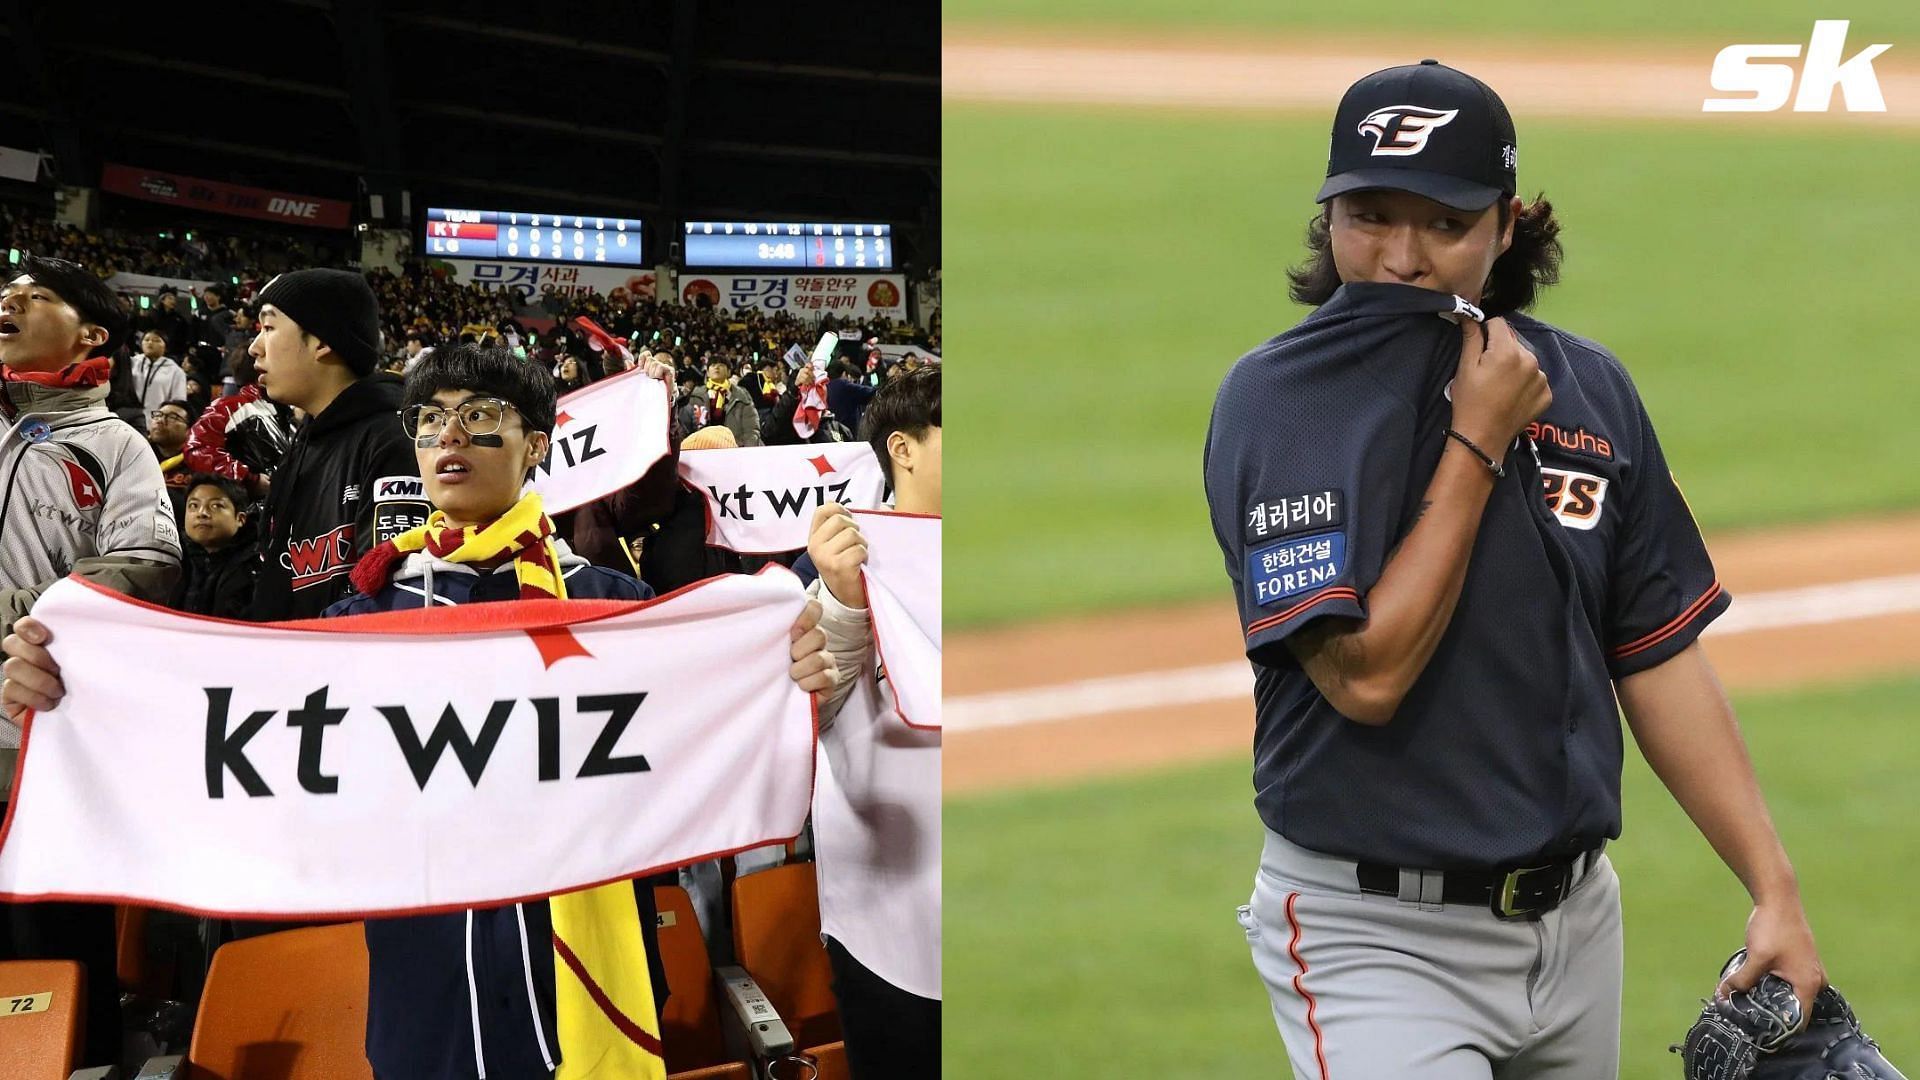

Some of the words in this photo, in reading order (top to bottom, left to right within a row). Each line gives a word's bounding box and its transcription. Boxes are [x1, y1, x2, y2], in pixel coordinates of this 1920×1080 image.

[266, 197, 321, 219] ONE
[443, 209, 480, 223] TEAM
[510, 213, 516, 224] 1
[531, 214, 539, 225] 2
[553, 215, 561, 226] 3
[574, 217, 582, 228] 4
[685, 222, 693, 233] 7
[704, 223, 712, 233] 8
[725, 223, 733, 233] 9
[744, 223, 757, 234] 10
[766, 223, 777, 234] 11
[787, 224, 800, 234] 12
[508, 227, 518, 241] 0
[530, 228, 540, 242] 0
[552, 230, 562, 243] 0
[574, 231, 584, 244] 0
[596, 232, 604, 245] 1
[617, 233, 627, 247] 0
[508, 242, 518, 256] 0
[530, 243, 540, 257] 0
[574, 246, 584, 259] 0
[595, 247, 605, 261] 2
[856, 253, 865, 266] 2
[876, 253, 884, 267] 1
[540, 266, 580, 283] 사과
[729, 278, 788, 309] 문경
[380, 481, 423, 496] KMI
[1249, 492, 1336, 536] 갤러리아
[1262, 539, 1331, 574] 한화건설
[1257, 562, 1337, 600] FORENA
[202, 684, 350, 799] kt
[10, 997, 34, 1014] 72
